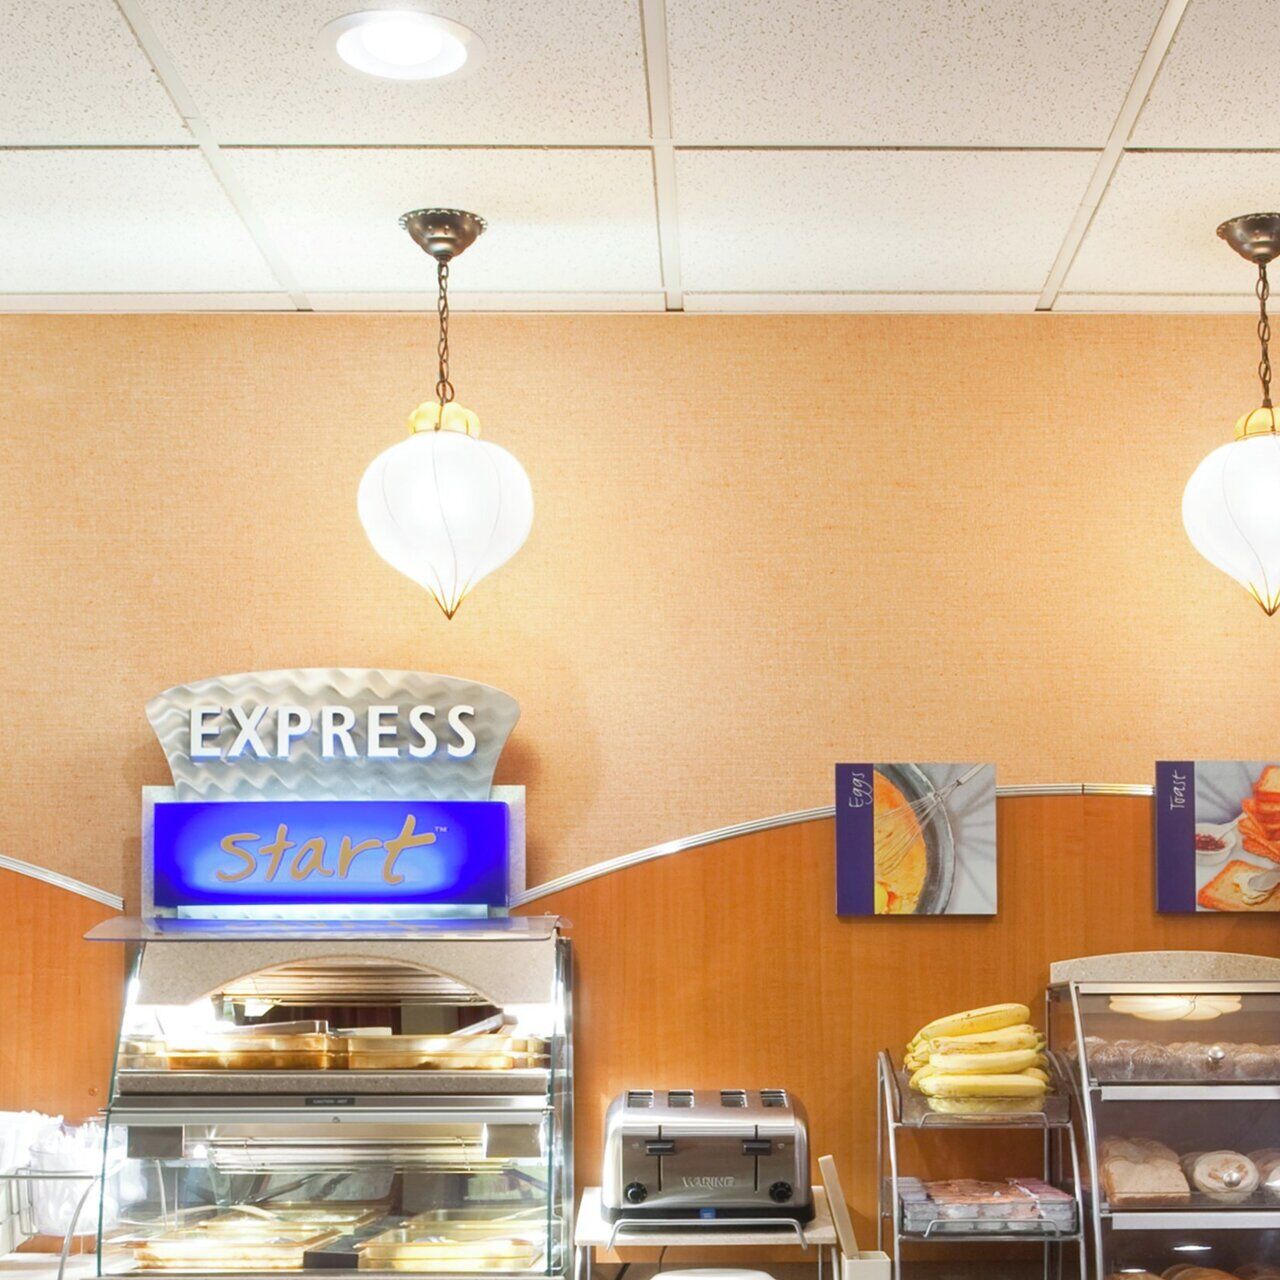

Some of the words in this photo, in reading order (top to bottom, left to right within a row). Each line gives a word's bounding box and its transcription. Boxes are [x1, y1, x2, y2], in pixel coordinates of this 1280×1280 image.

[188, 703, 477, 761] EXPRESS
[848, 770, 873, 808] Eggs
[1169, 769, 1187, 811] Toast
[215, 813, 437, 886] start
